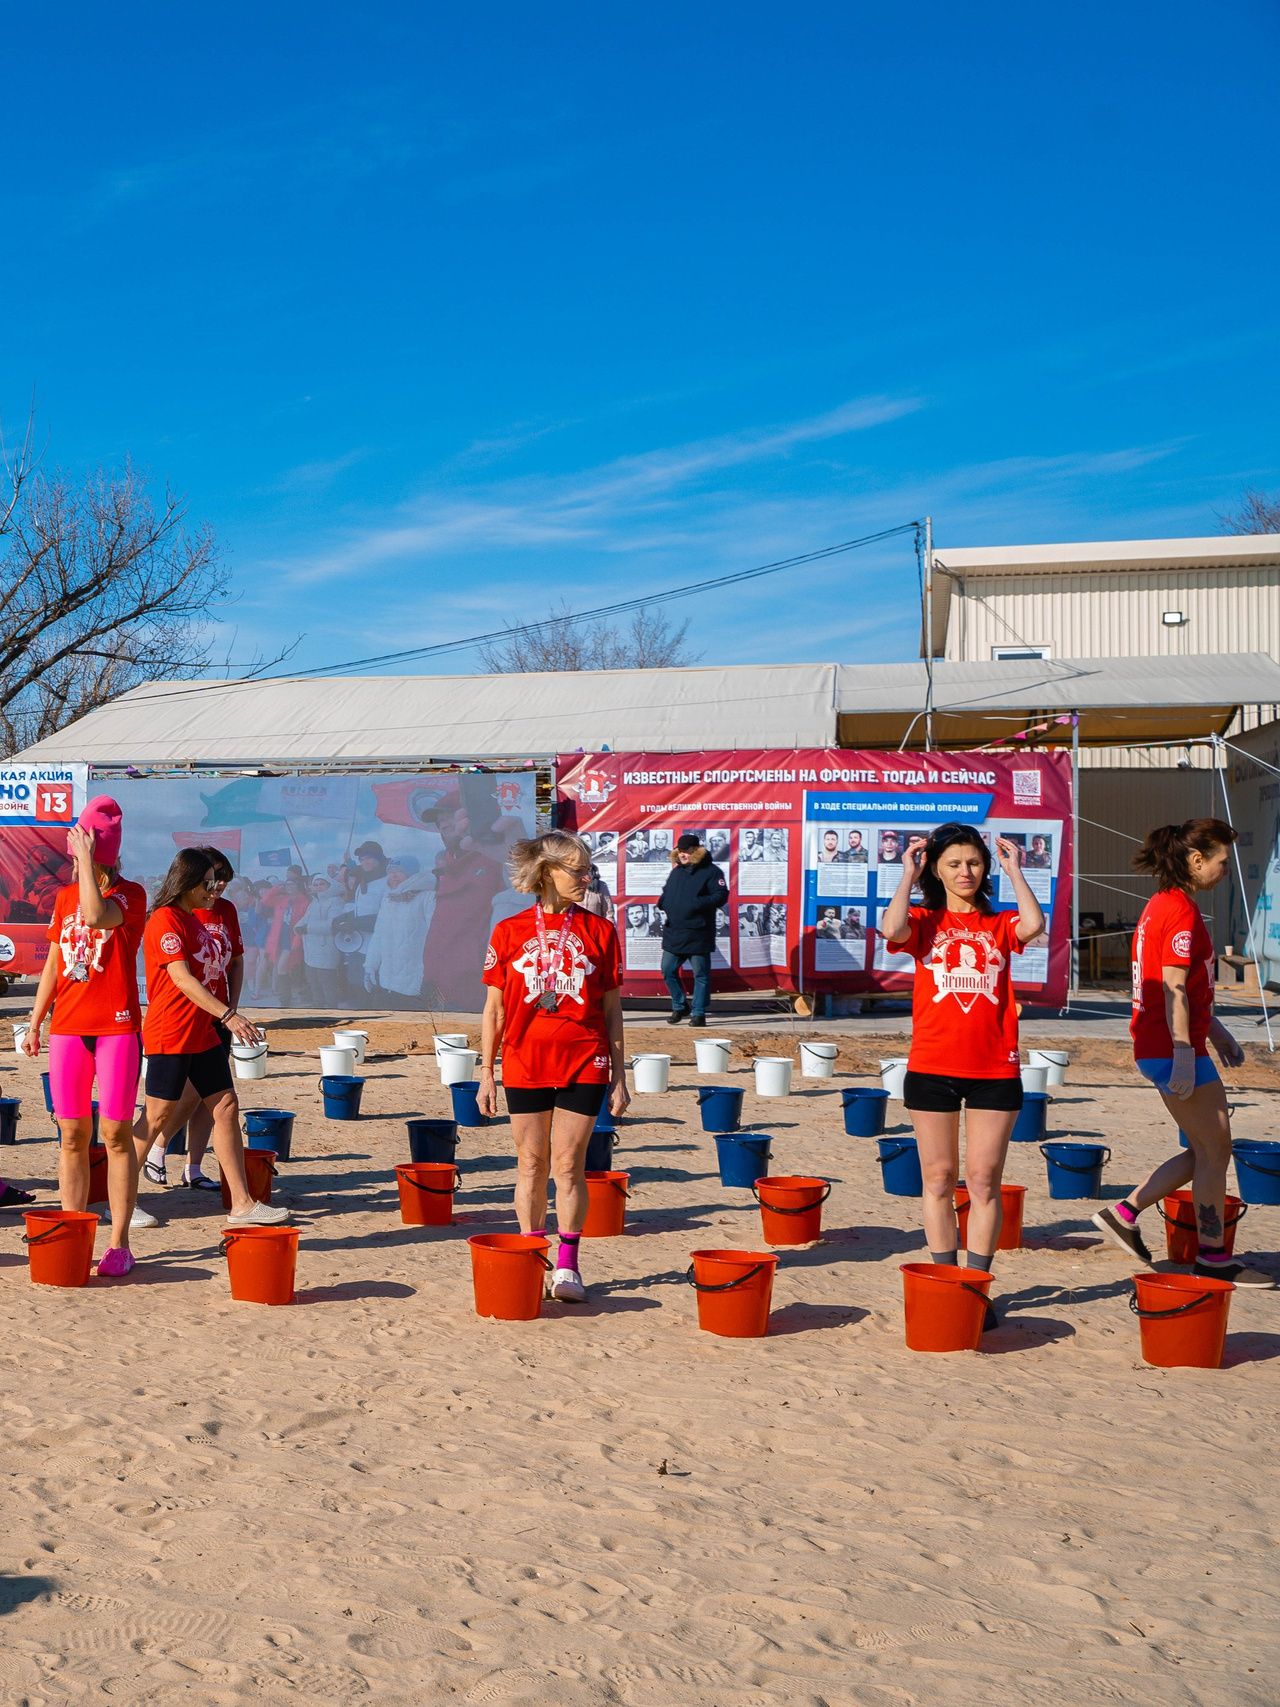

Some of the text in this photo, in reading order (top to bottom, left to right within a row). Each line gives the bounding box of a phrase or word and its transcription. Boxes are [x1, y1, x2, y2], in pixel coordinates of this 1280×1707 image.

[29, 771, 73, 781] АКЦИЯ
[623, 768, 996, 785] ИЗВЕСТНЫЕ СПОРТСМЕНЫ НА ФРОНТЕ. ТОГДА И СЕЙЧАС
[41, 792, 67, 813] 13
[640, 805, 645, 813] В
[668, 802, 702, 812] ВЕЛИКОЙ
[703, 802, 763, 811] ОТЕЧЕСТВЕННОЙ
[764, 801, 792, 811] ВОЙНЫ
[814, 801, 978, 813] В ХОДЕ СПЕЦИАЛЬНОЙ ВОЕННОЙ ОПЕРАЦИИ
